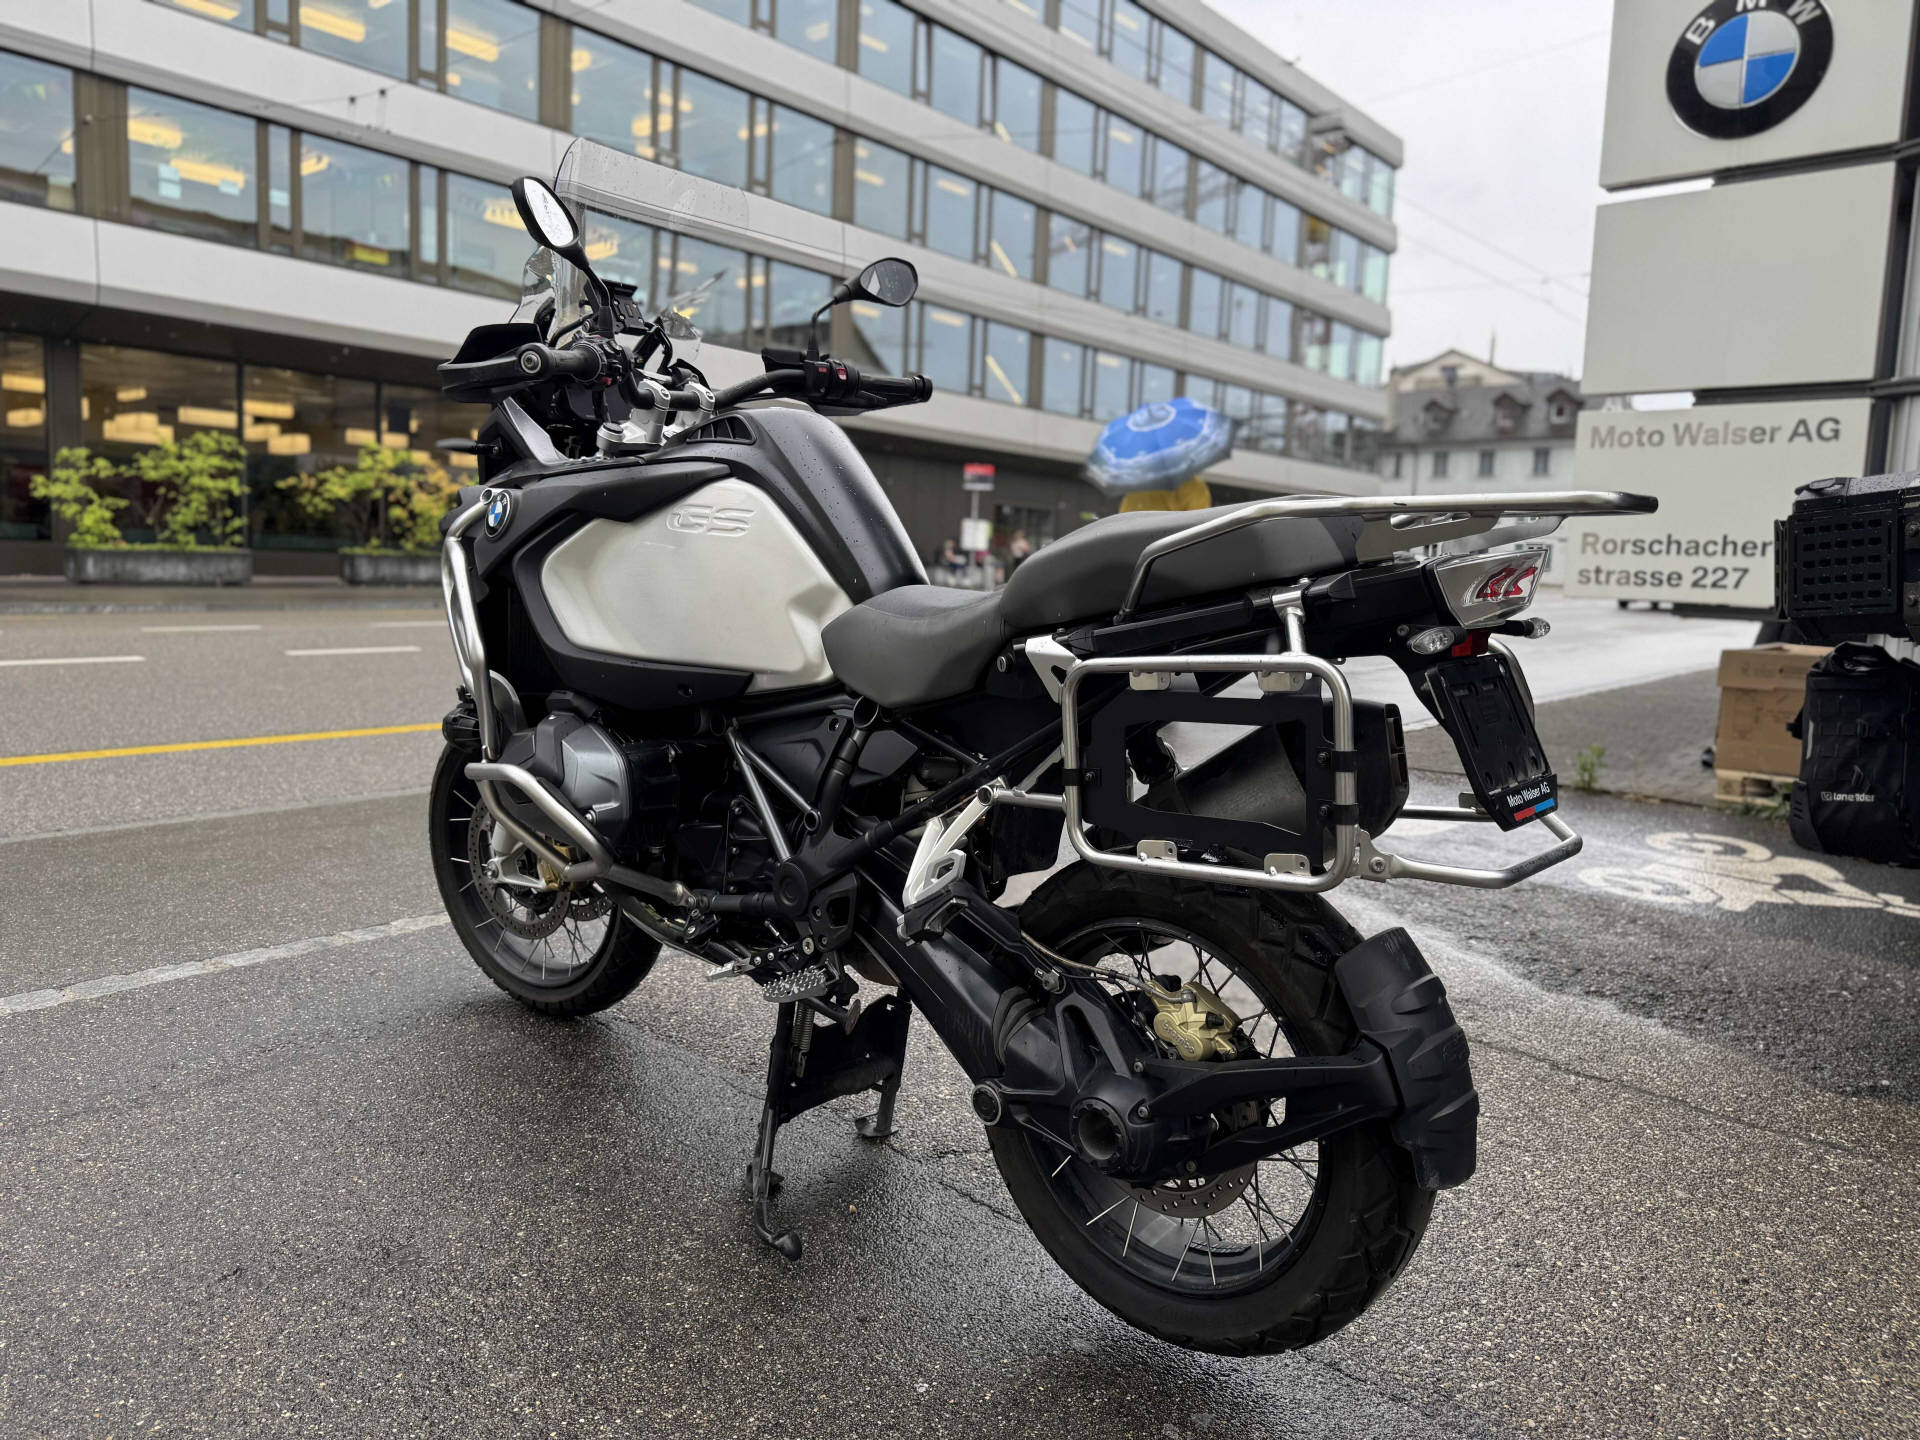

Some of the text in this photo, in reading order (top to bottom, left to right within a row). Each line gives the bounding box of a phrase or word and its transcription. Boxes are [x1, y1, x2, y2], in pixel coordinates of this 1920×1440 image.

[1684, 0, 1822, 45] BMW
[1590, 417, 1842, 449] Moto Walser AG
[666, 504, 757, 537] GS
[1580, 532, 1773, 557] Rorschacher
[1577, 566, 1750, 589] strasse 227
[1506, 781, 1551, 807] Moto Walser AG
